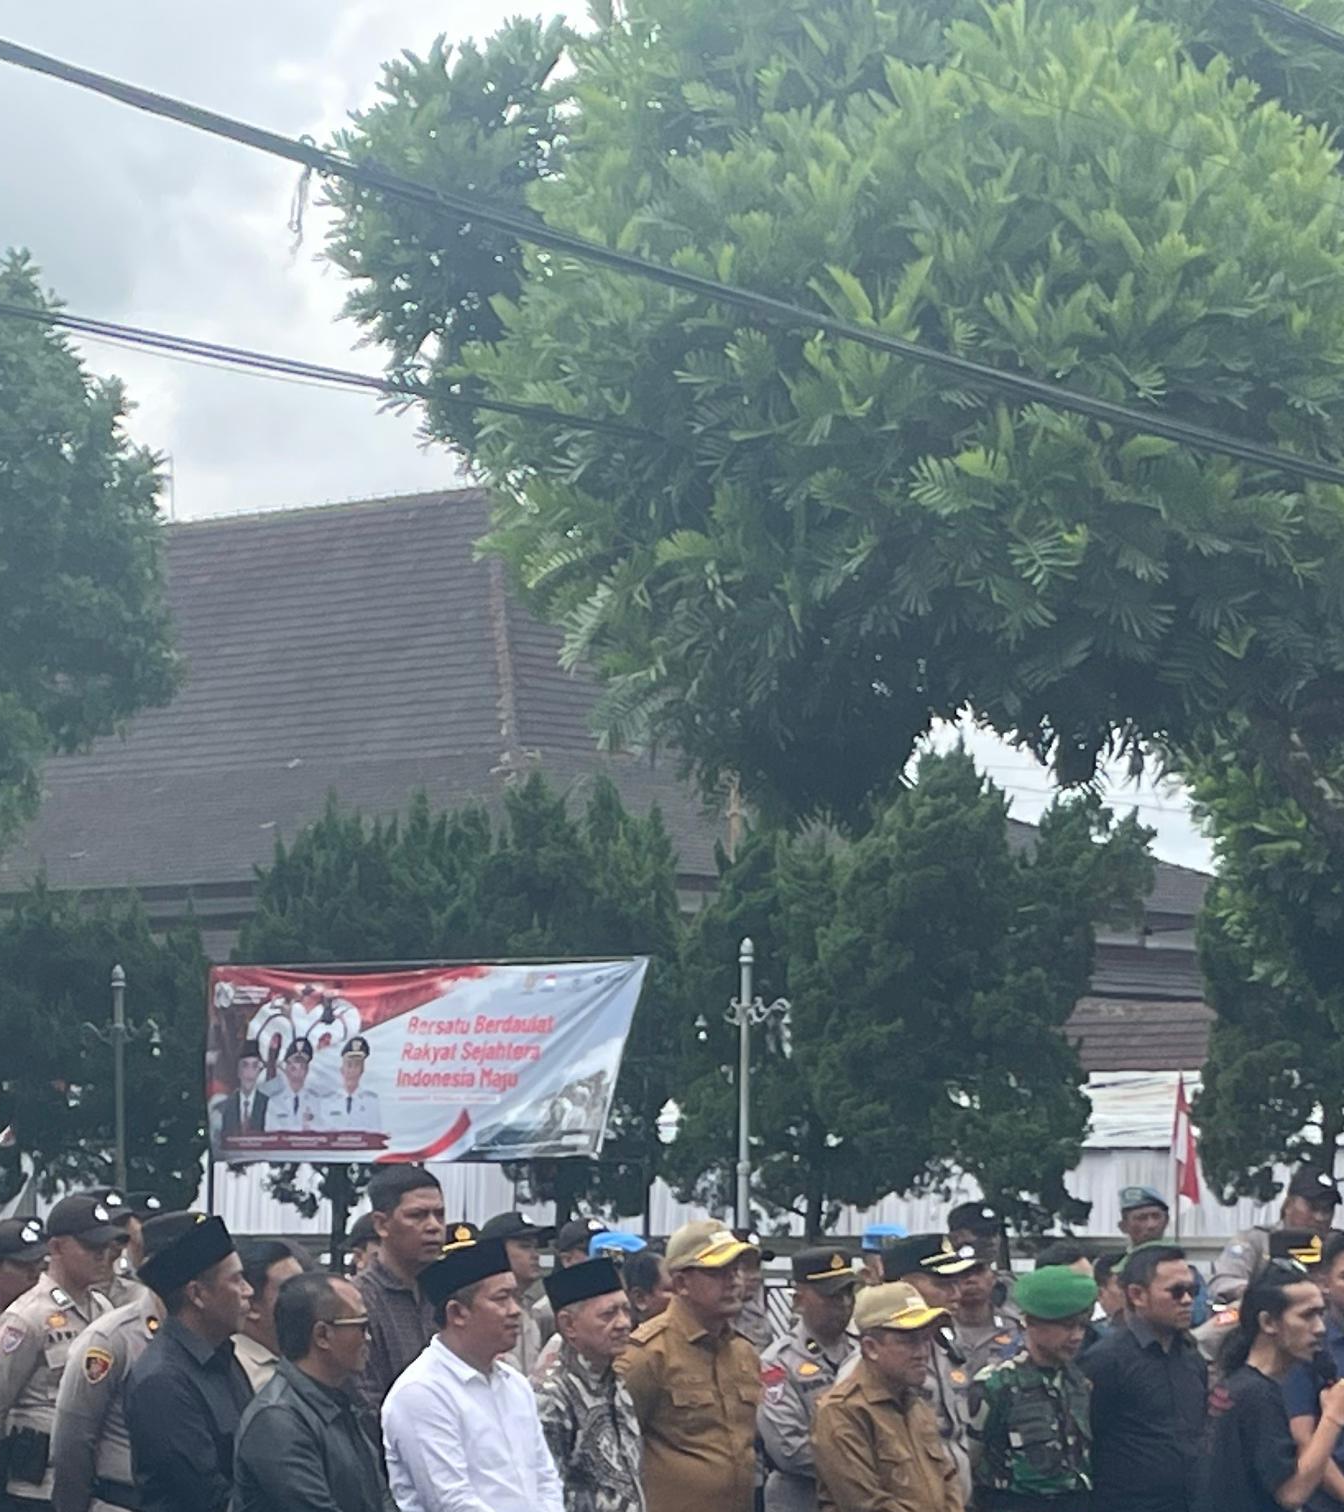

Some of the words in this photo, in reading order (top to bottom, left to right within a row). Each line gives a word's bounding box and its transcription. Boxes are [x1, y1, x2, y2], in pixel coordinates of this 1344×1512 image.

[407, 1016, 470, 1034] Bersatu
[474, 1014, 554, 1034] Berdaulat
[401, 1043, 457, 1065] Rakyat
[461, 1040, 541, 1065] Sejahtera
[396, 1069, 475, 1088] Indonesia
[479, 1068, 519, 1092] Maju
